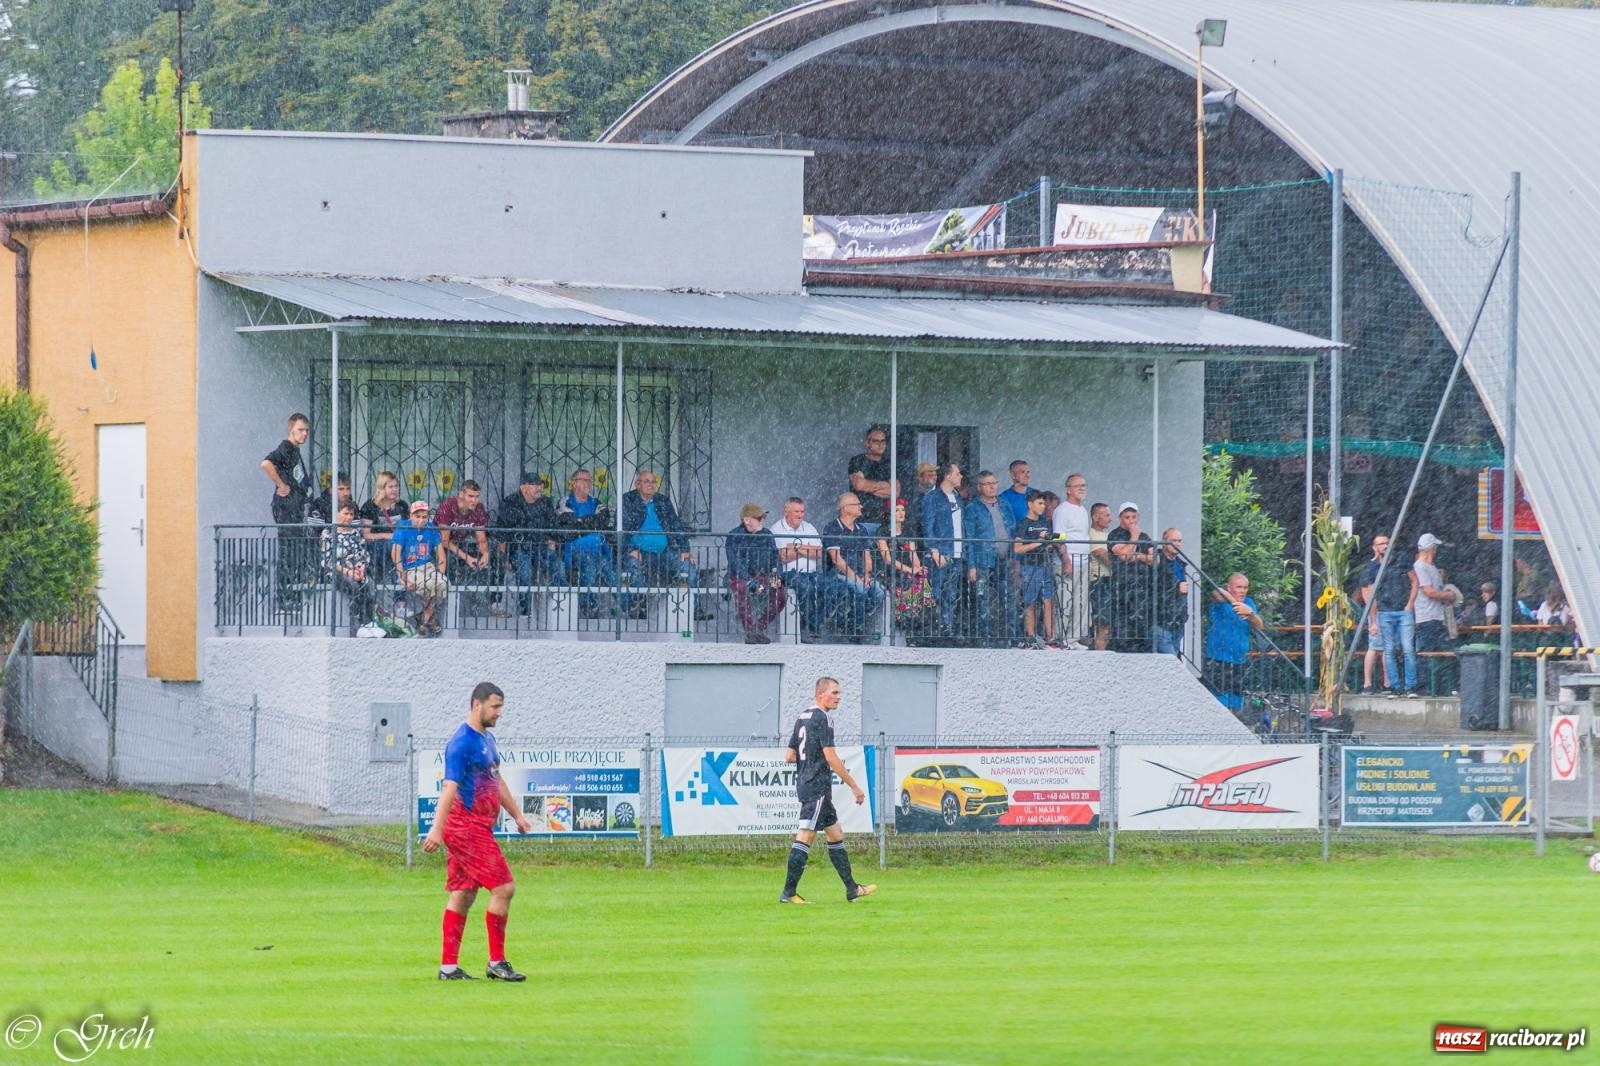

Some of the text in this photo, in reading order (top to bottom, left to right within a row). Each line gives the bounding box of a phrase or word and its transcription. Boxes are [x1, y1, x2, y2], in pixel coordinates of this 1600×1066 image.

[798, 726, 807, 760] 2
[520, 750, 561, 766] TWOJE
[564, 750, 626, 766] PRZYJĘCIE
[980, 755, 1095, 765] BLACHARSTWO SAMOCHODOWE
[991, 766, 1085, 775] NAPRAWY POWYPADKOWE
[759, 790, 787, 798] ROMAN
